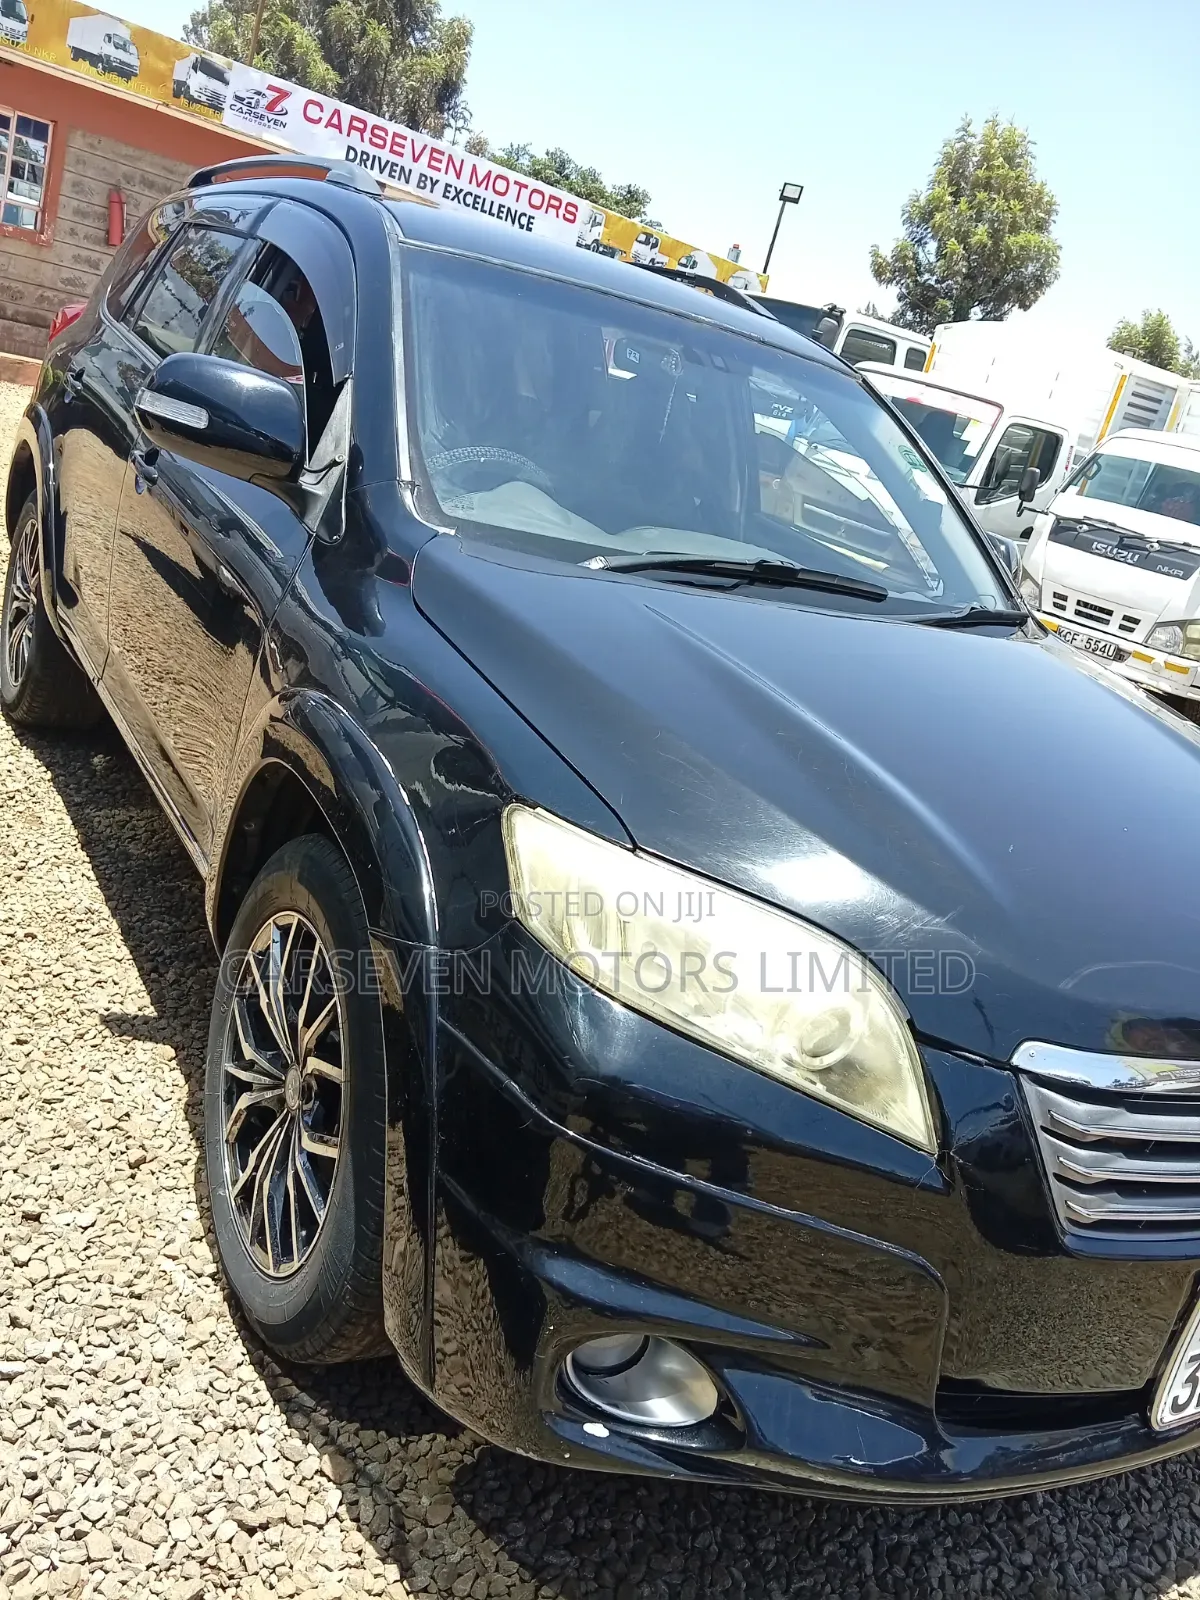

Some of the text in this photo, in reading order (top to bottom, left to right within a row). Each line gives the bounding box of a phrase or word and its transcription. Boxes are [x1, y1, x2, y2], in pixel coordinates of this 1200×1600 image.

[0, 35, 57, 61] SUZU NKR
[180, 94, 208, 114] ISUZU
[229, 103, 287, 129] CARSEVEN
[242, 115, 272, 129] MOTORS
[302, 98, 579, 225] CARSEVEN MOTORS
[345, 144, 535, 232] DRIVEN BY EXCELLENCE
[1091, 541, 1140, 564] ISUZU
[1156, 564, 1184, 577] NKR
[1057, 627, 1117, 658] KCF 554U
